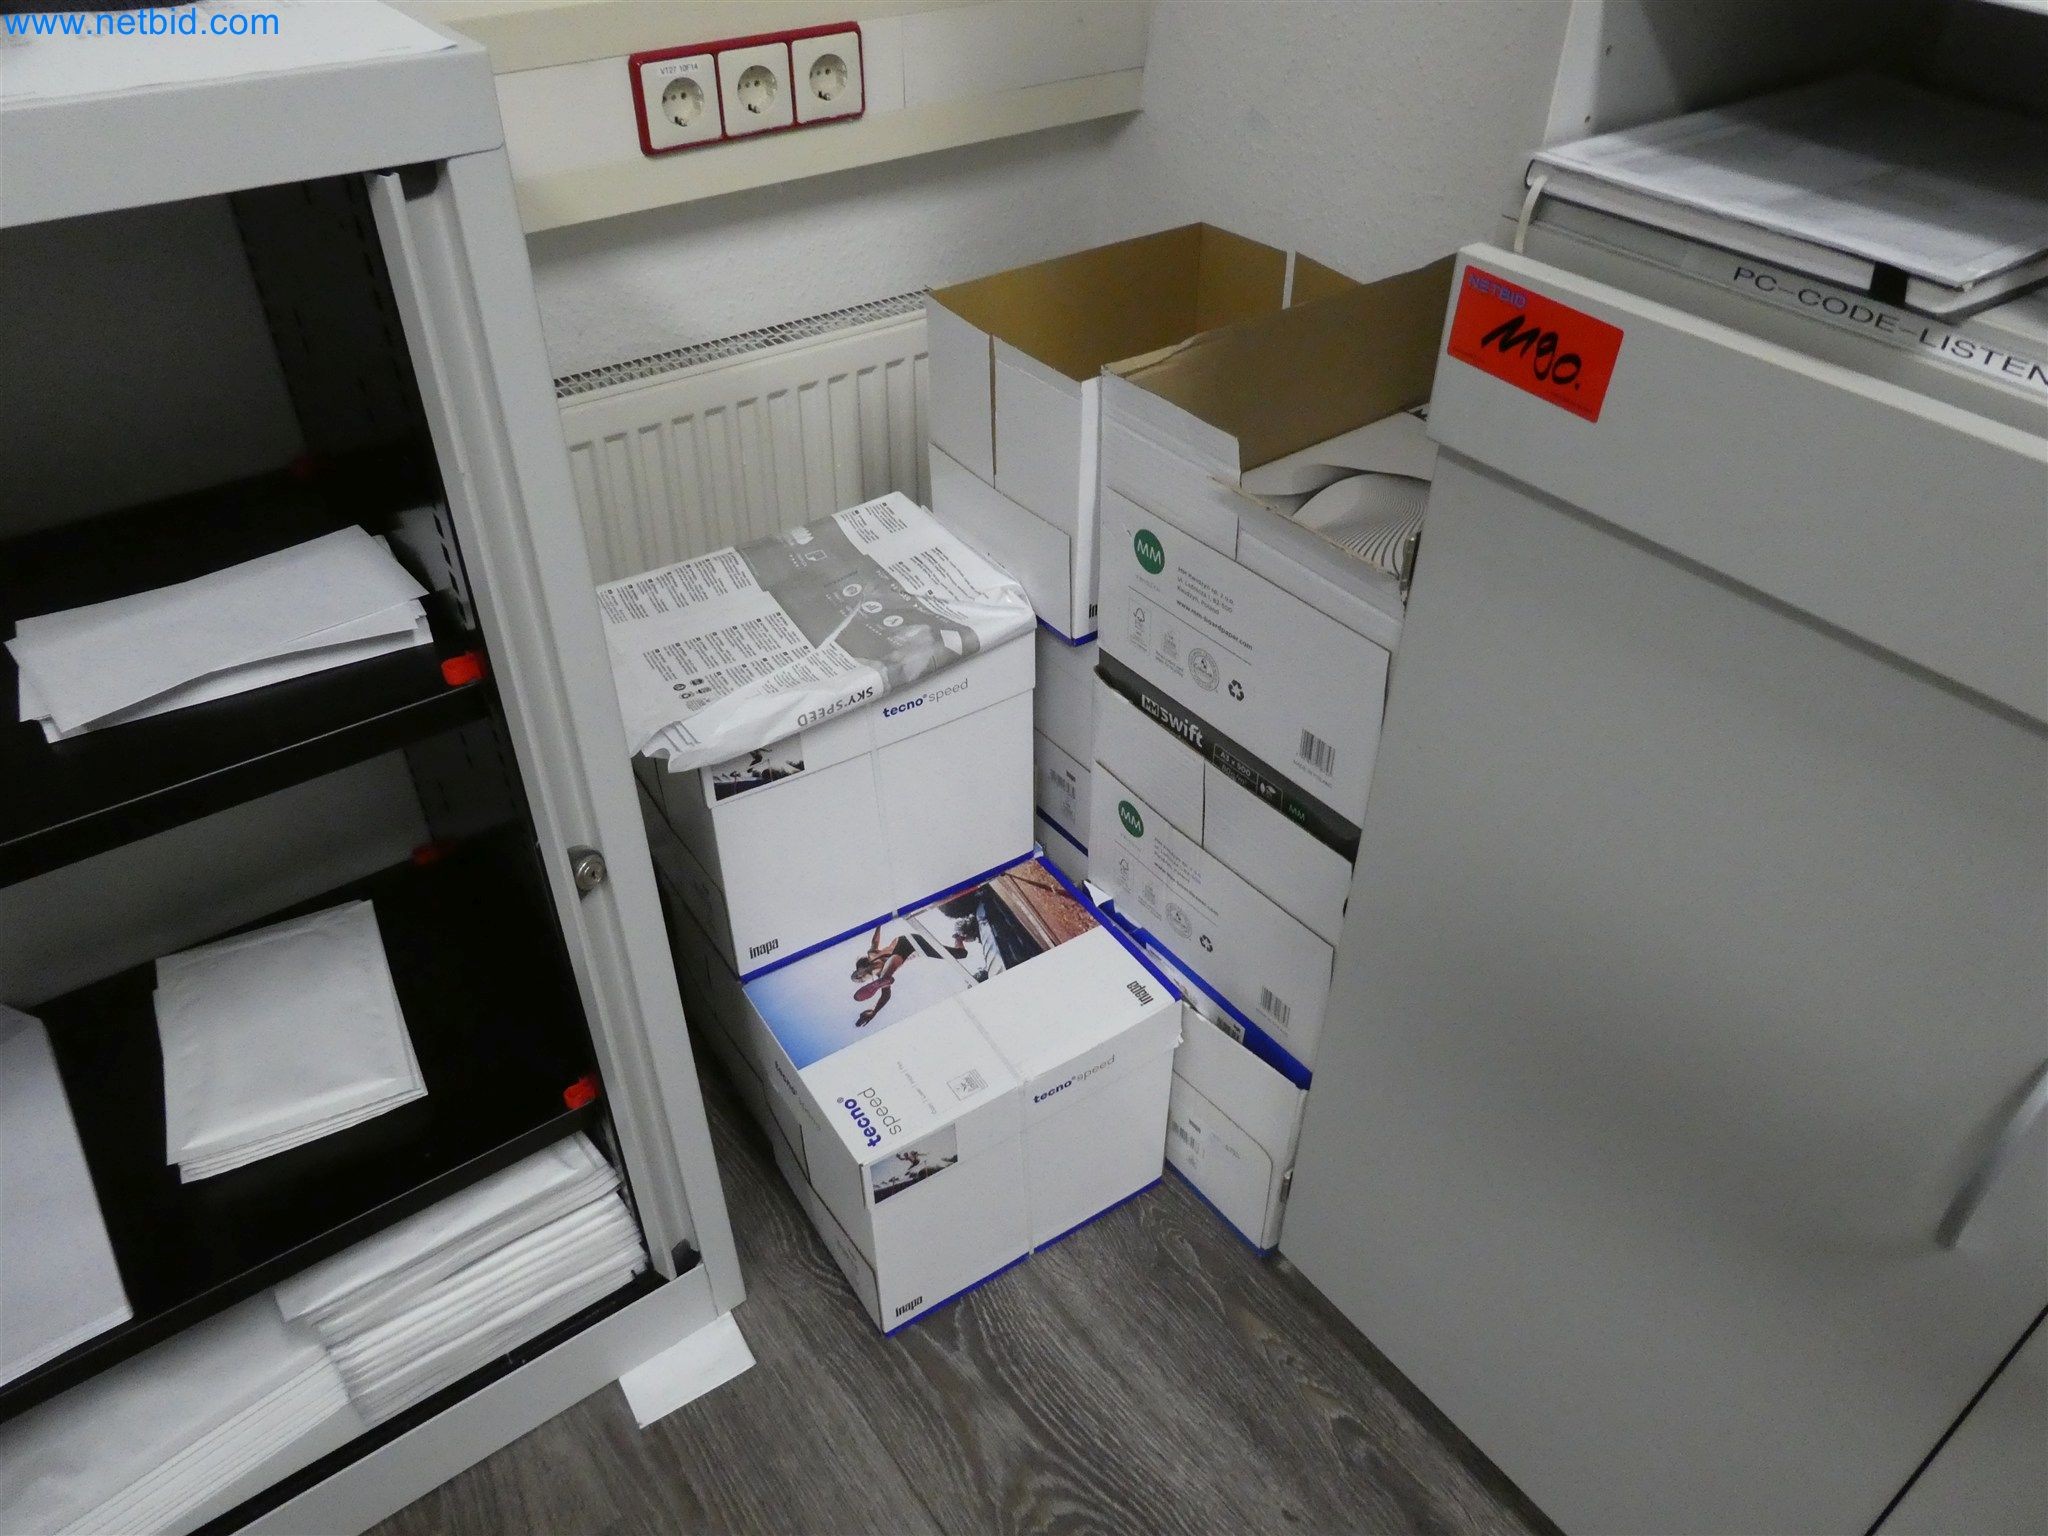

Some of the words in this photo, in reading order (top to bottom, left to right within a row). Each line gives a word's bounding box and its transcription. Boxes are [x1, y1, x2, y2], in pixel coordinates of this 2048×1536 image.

[1468, 274, 1528, 309] NETBID
[1136, 537, 1162, 566] MM
[1159, 706, 1204, 749] swift
[1120, 806, 1142, 833] MM
[749, 938, 779, 959] inapa
[1126, 980, 1154, 1007] inapa
[857, 1087, 902, 1136] speed
[895, 1295, 923, 1318] inapa
